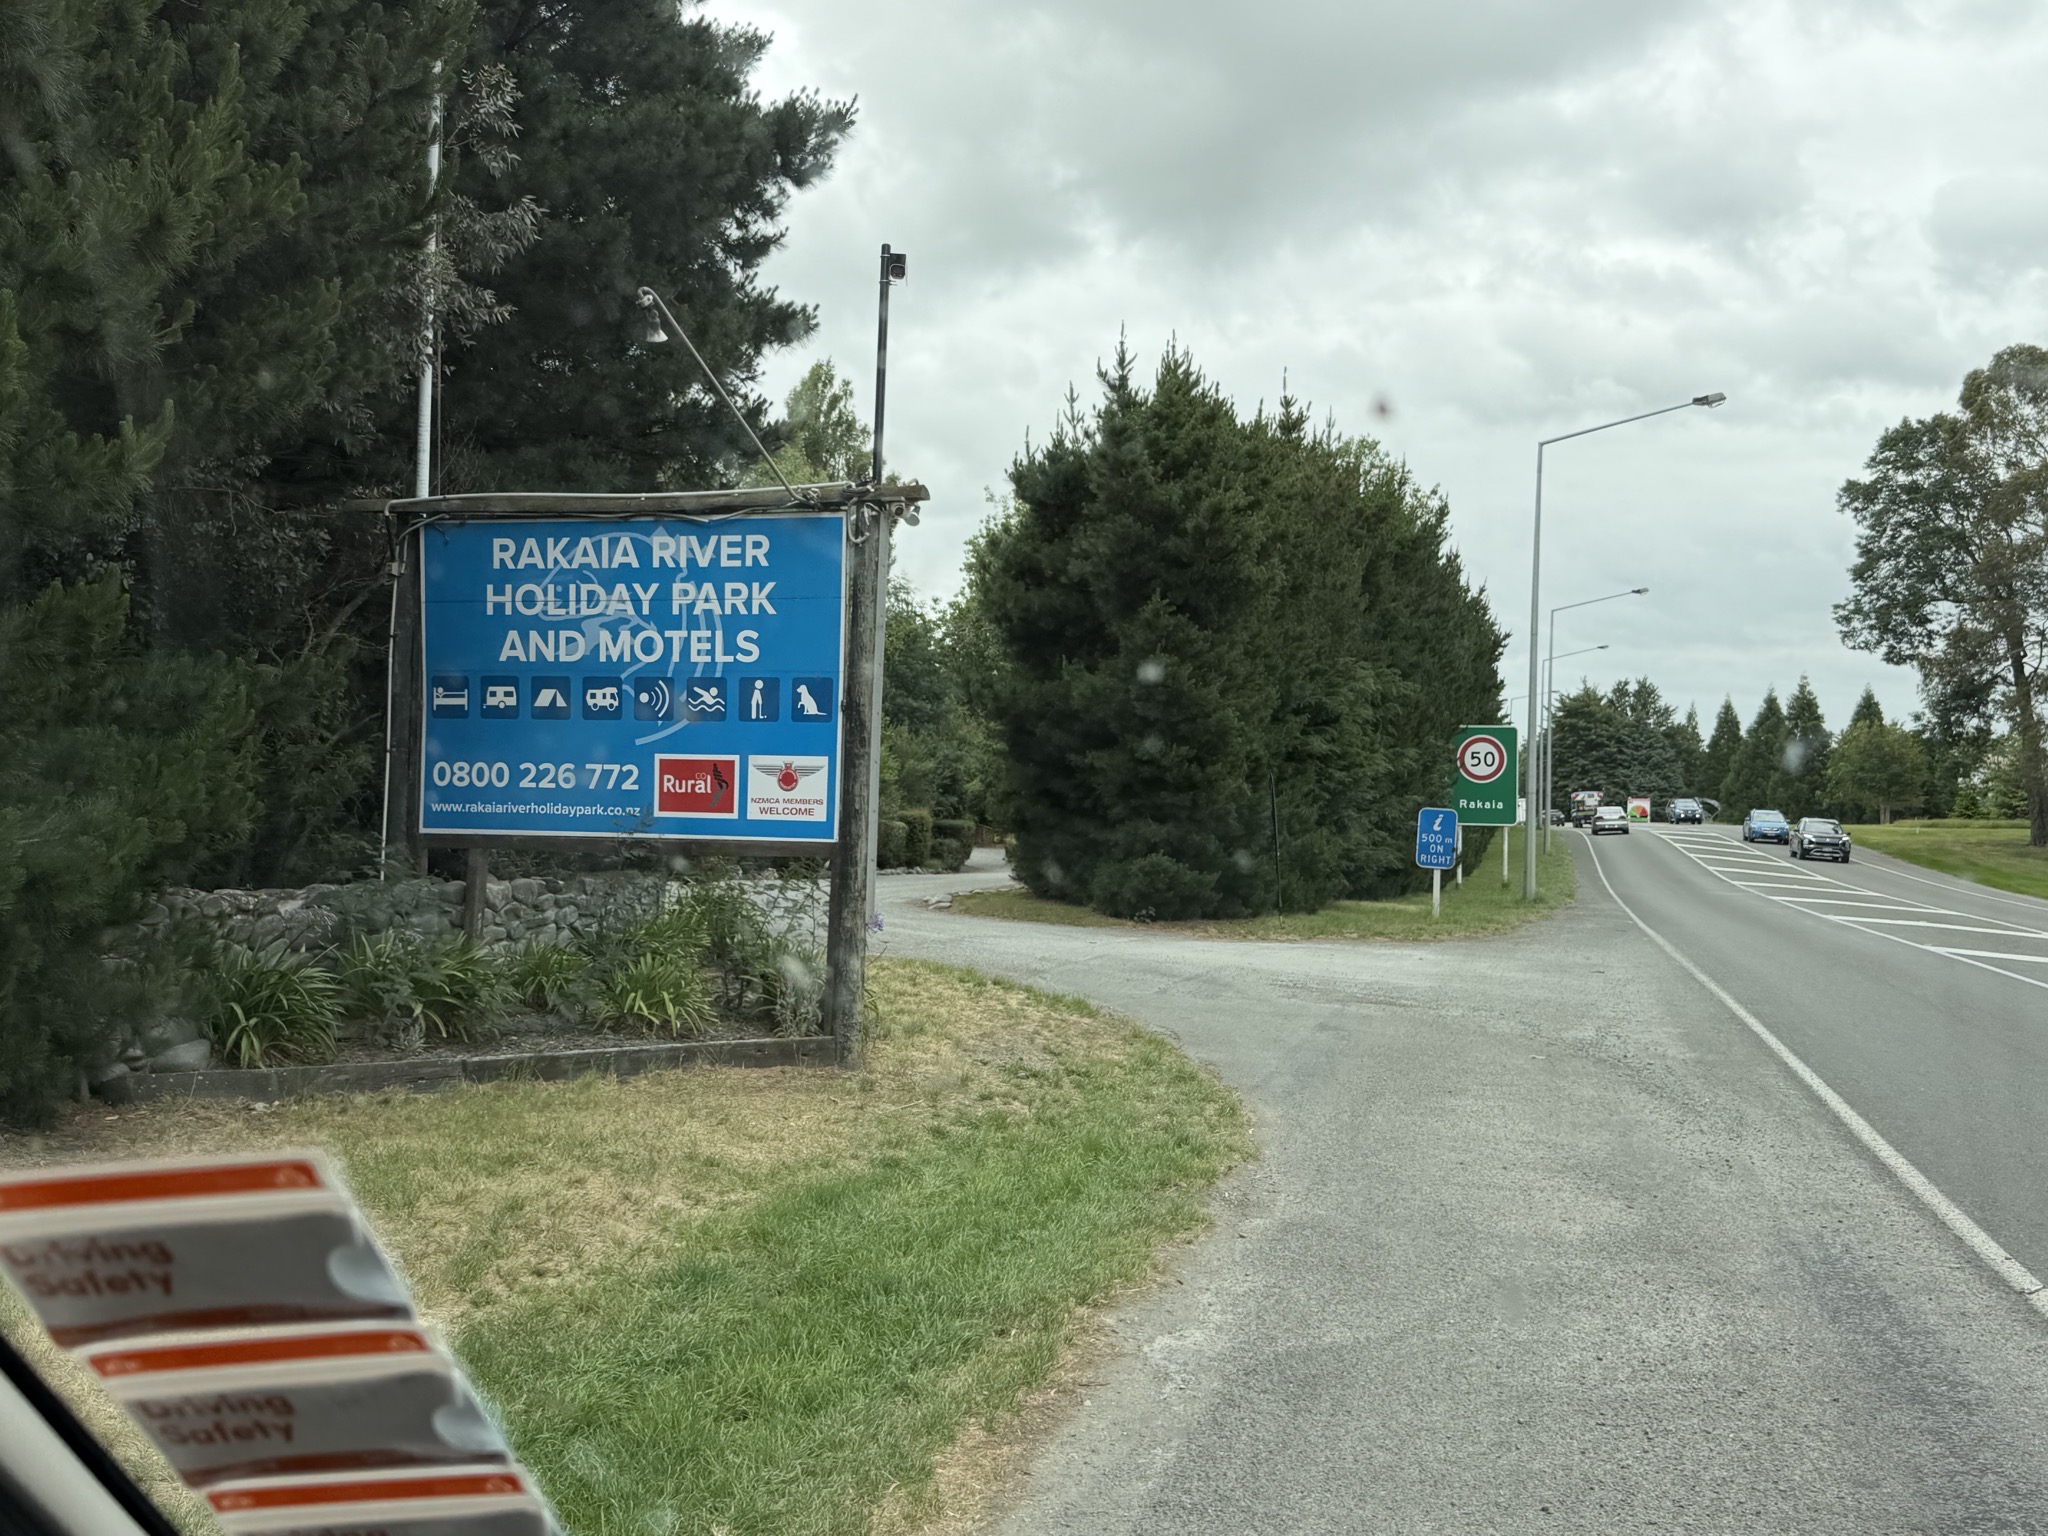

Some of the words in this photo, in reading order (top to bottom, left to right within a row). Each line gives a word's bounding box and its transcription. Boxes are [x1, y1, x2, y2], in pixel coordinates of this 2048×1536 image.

[493, 537, 639, 569] RAKAIA
[652, 534, 770, 568] RIVER
[486, 583, 662, 615] HOLIDAY
[671, 582, 777, 616] PARK
[499, 630, 586, 663] AND
[599, 629, 760, 663] MOTELS
[1470, 751, 1496, 767] 50
[433, 761, 510, 788] 0800
[519, 762, 576, 789] 226
[585, 763, 640, 790] 772
[663, 774, 712, 794] Rural
[750, 797, 780, 805] NZMCA
[782, 798, 824, 806] MEMBERS
[1459, 799, 1504, 809] Rakaia
[758, 806, 815, 817] WELCOME
[1421, 833, 1443, 844] 500
[1429, 843, 1444, 854] ON
[1420, 854, 1451, 865] RIGHT
[156, 1419, 296, 1446] Safety
